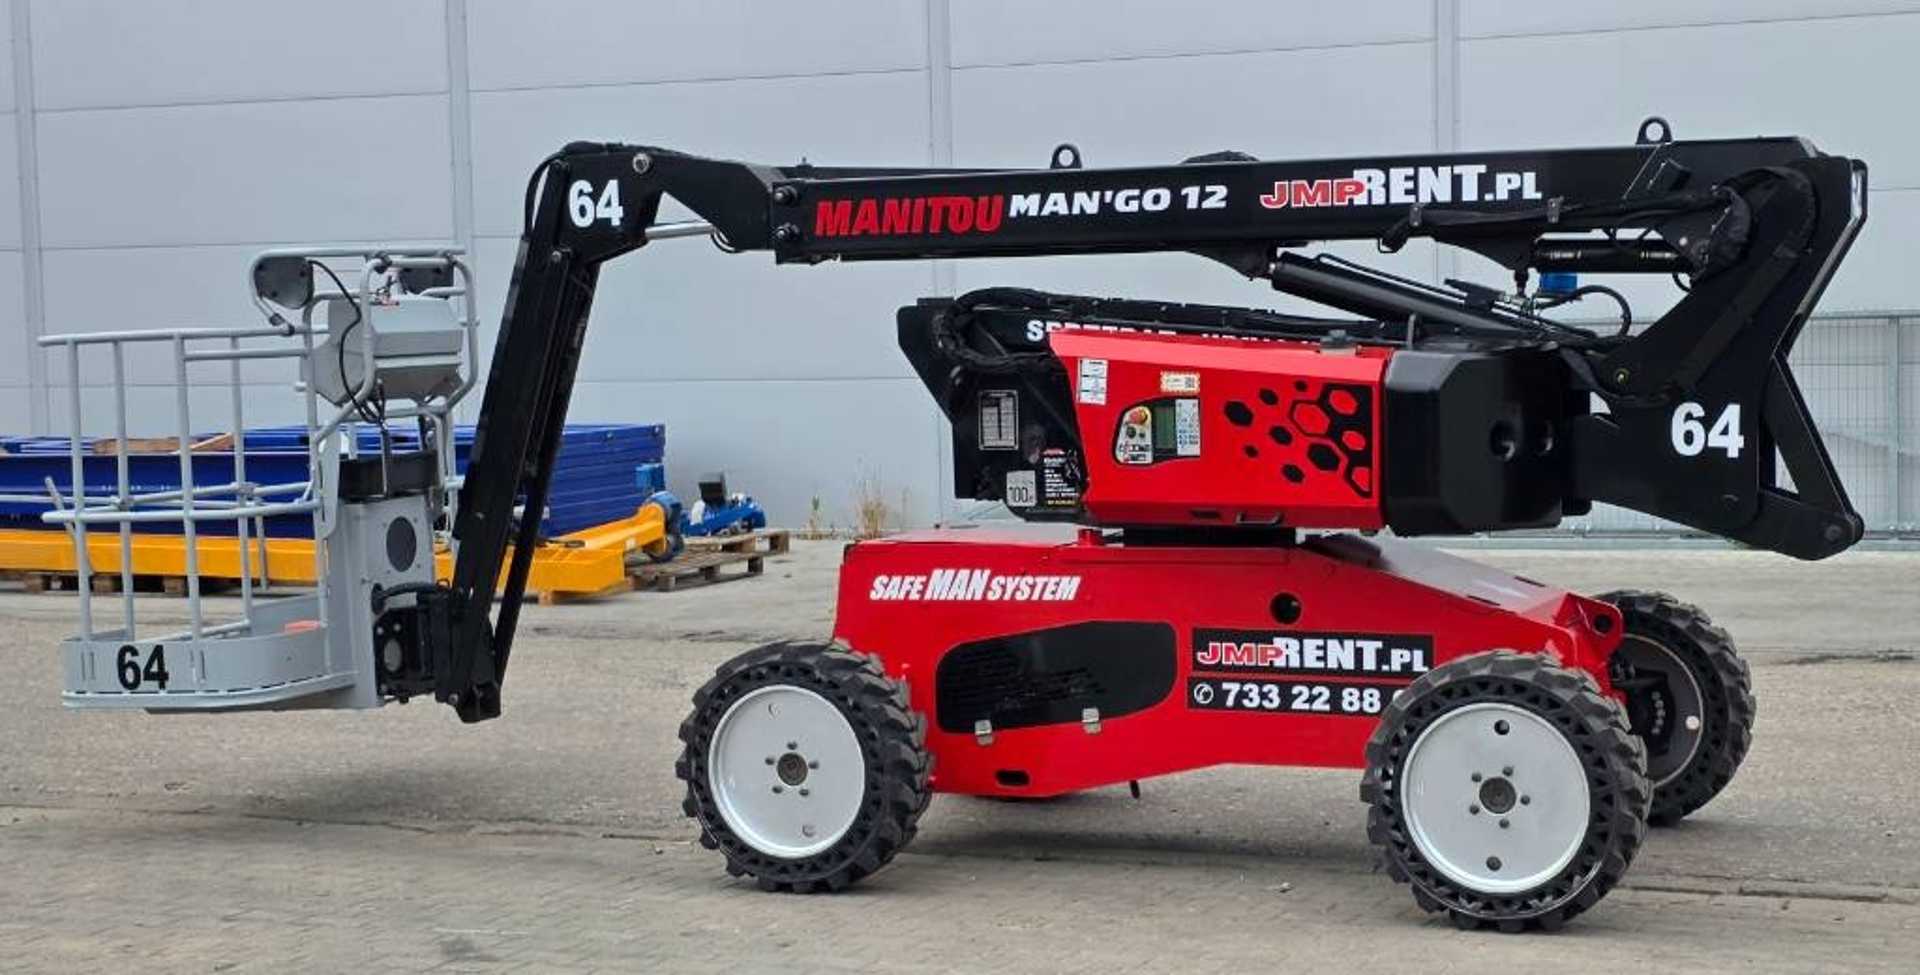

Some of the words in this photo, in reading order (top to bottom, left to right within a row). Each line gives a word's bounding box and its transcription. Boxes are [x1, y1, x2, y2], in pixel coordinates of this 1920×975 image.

[568, 179, 624, 228] 64
[815, 195, 1004, 237] MANITOU
[1008, 187, 1171, 218] MAN'GO
[1180, 184, 1228, 210] 12
[1671, 402, 1745, 459] 64
[869, 575, 927, 601] SAFE
[923, 568, 991, 601] MAN
[987, 575, 1082, 601] SYSTEM
[116, 644, 170, 691] 64
[1221, 682, 1281, 709] 733
[1290, 685, 1331, 712] 22
[1341, 688, 1381, 713] 88
